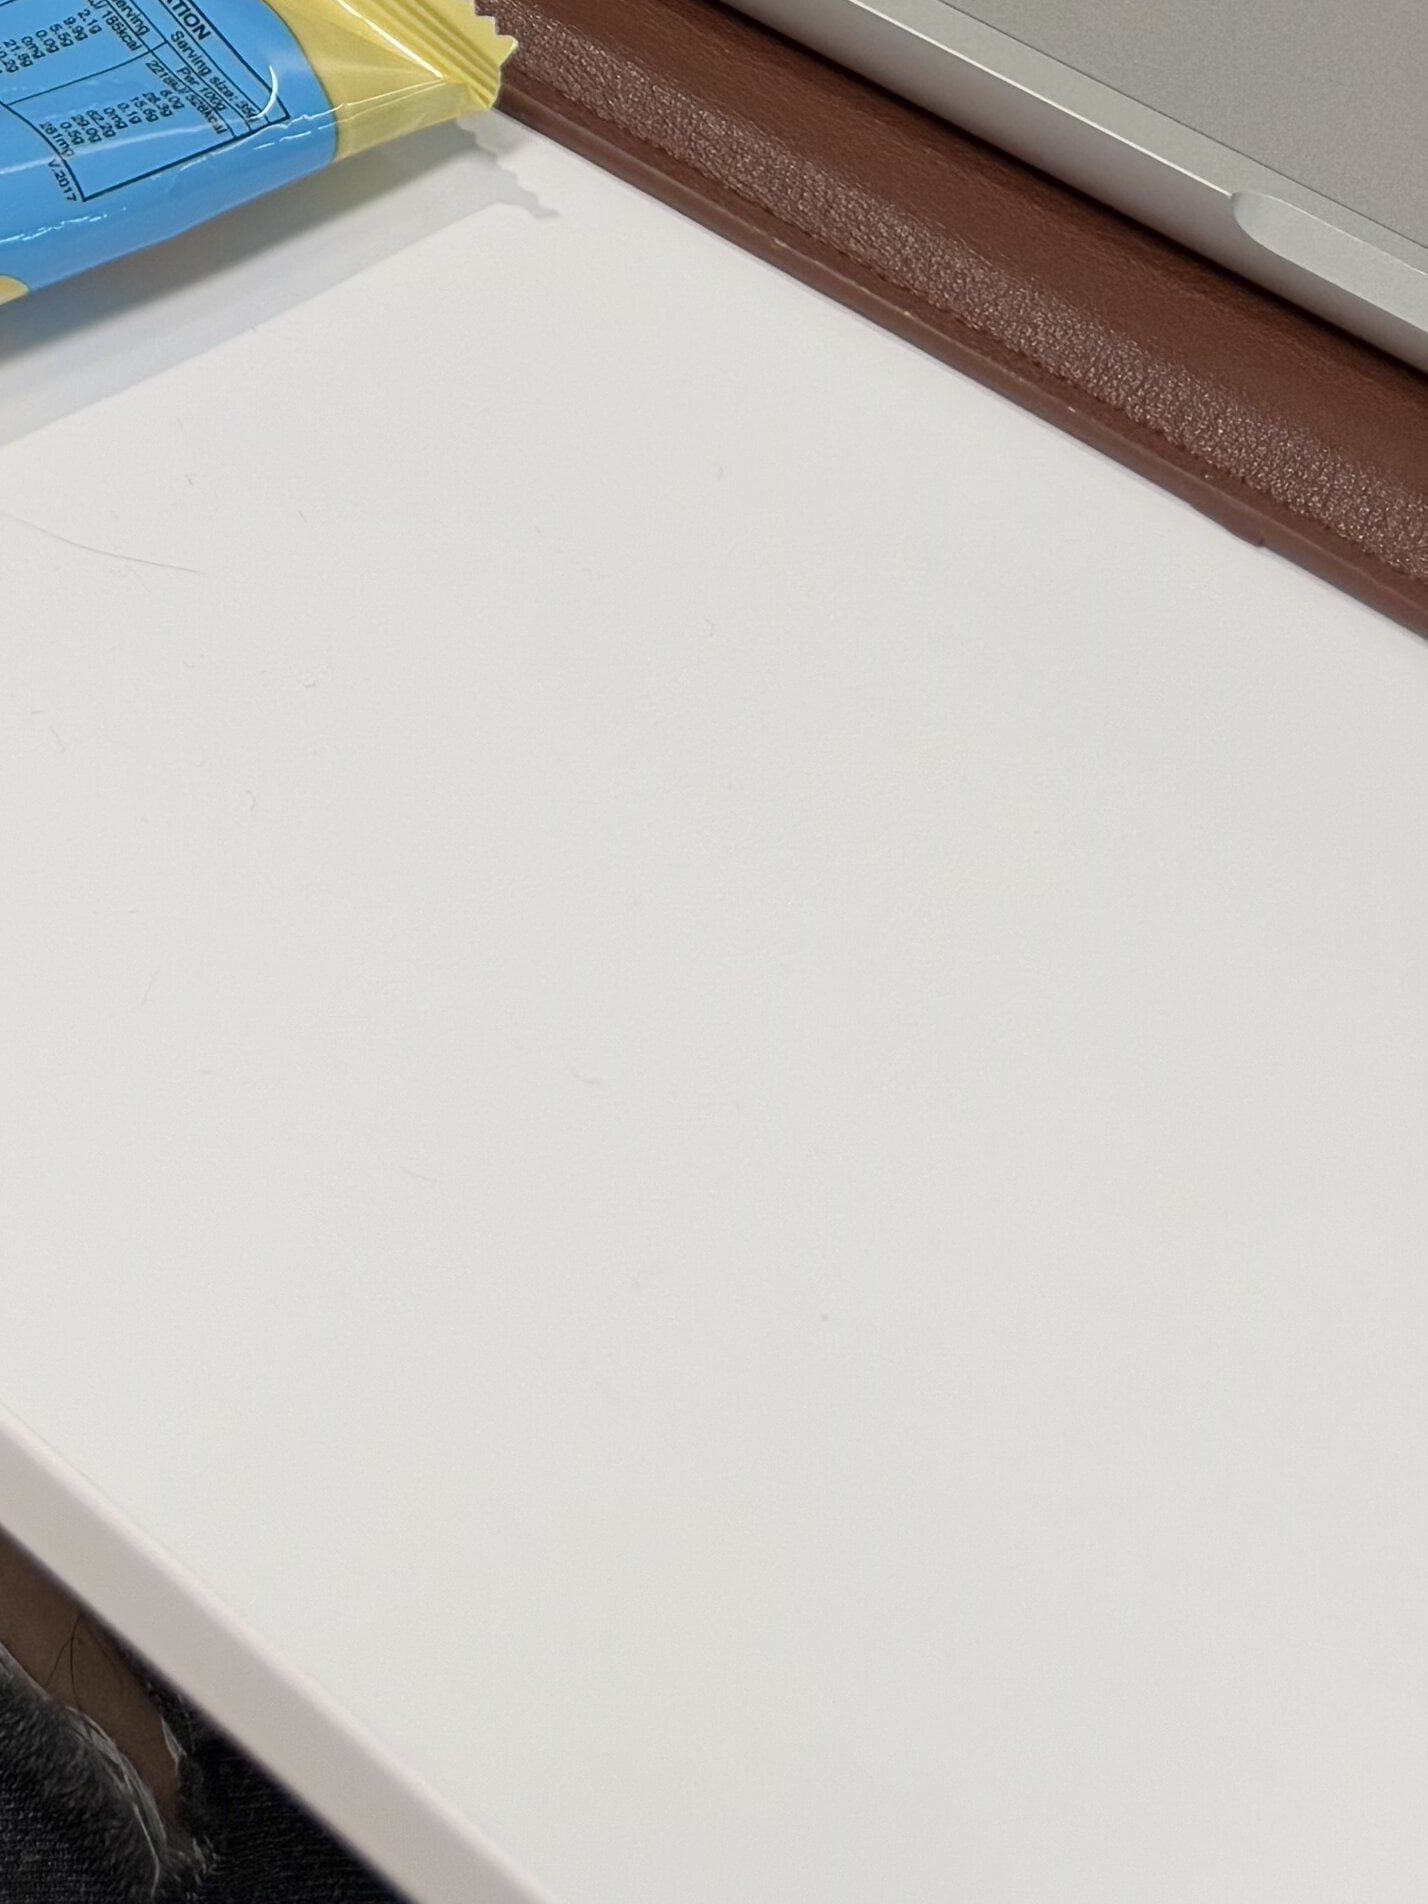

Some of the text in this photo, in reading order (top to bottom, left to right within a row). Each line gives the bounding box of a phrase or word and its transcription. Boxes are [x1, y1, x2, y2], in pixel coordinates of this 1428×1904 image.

[76, 8, 102, 35] 2.1g
[20, 36, 46, 60] 0mg
[102, 107, 129, 130] 0mg
[34, 29, 60, 54] 0.0g
[116, 102, 143, 125] 0.1g
[170, 30, 238, 102] Serving size:
[176, 66, 227, 112] Per 100g
[59, 121, 86, 146] 0.5g
[70, 114, 102, 144] 29.0g
[48, 160, 78, 202] V.2017
